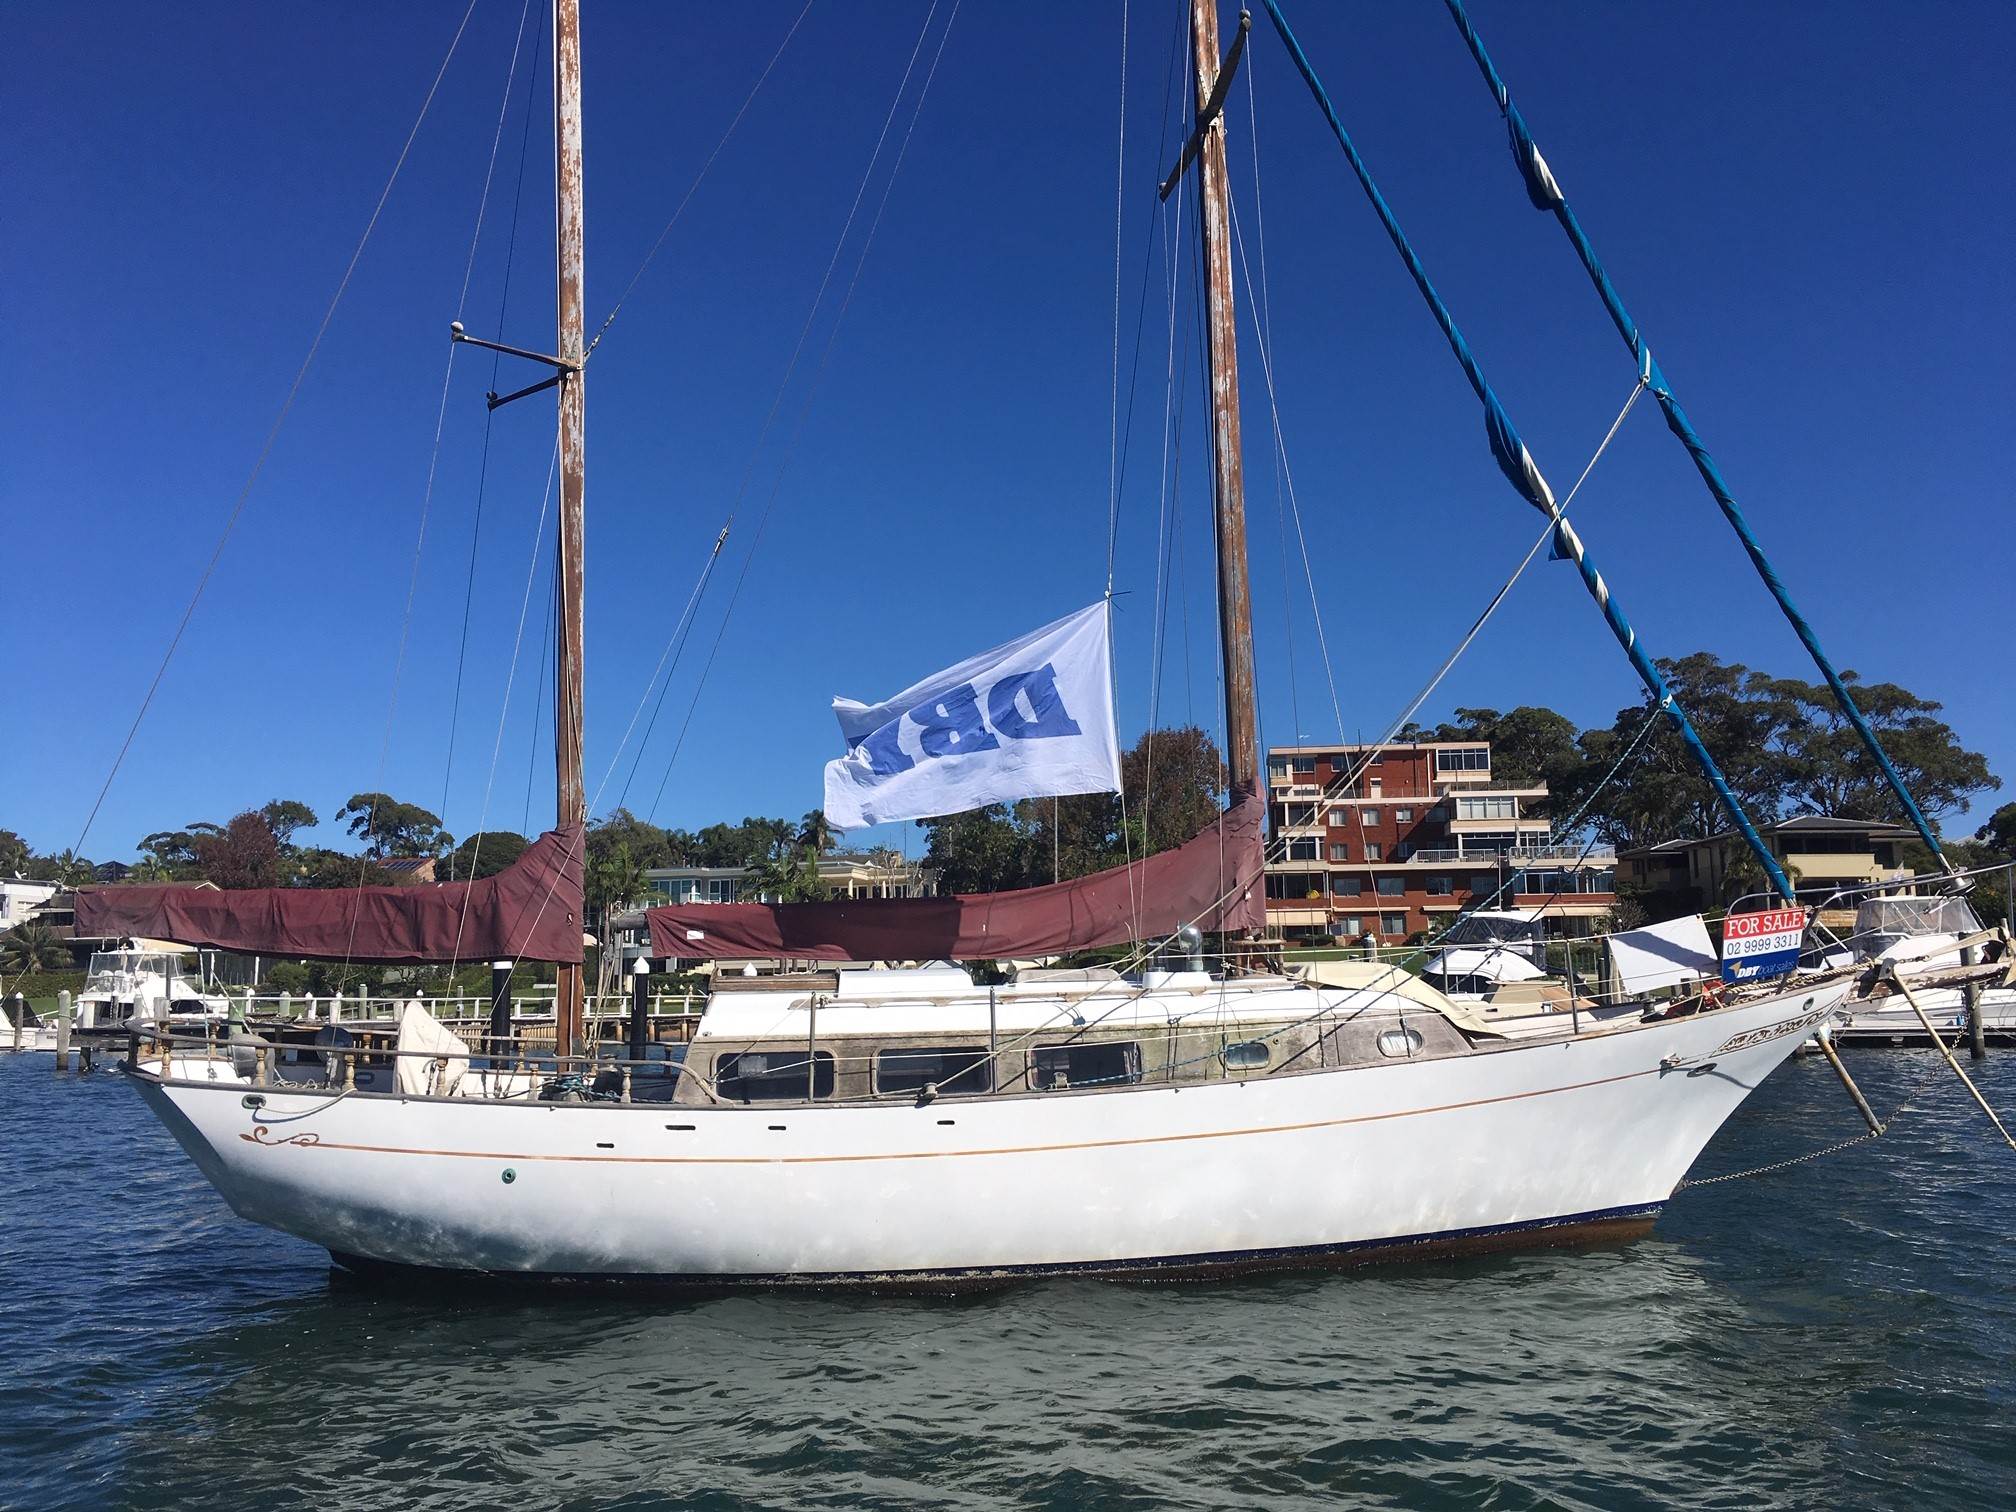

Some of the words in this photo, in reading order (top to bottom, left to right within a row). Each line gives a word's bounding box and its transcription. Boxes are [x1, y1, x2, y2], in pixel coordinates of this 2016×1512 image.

[1728, 917, 1759, 937] FOR
[1763, 912, 1802, 932] SALE
[1727, 942, 1741, 955] 02
[1744, 938, 1771, 953] 9999
[1774, 934, 1798, 948] 3311
[1736, 966, 1760, 978] DBY
